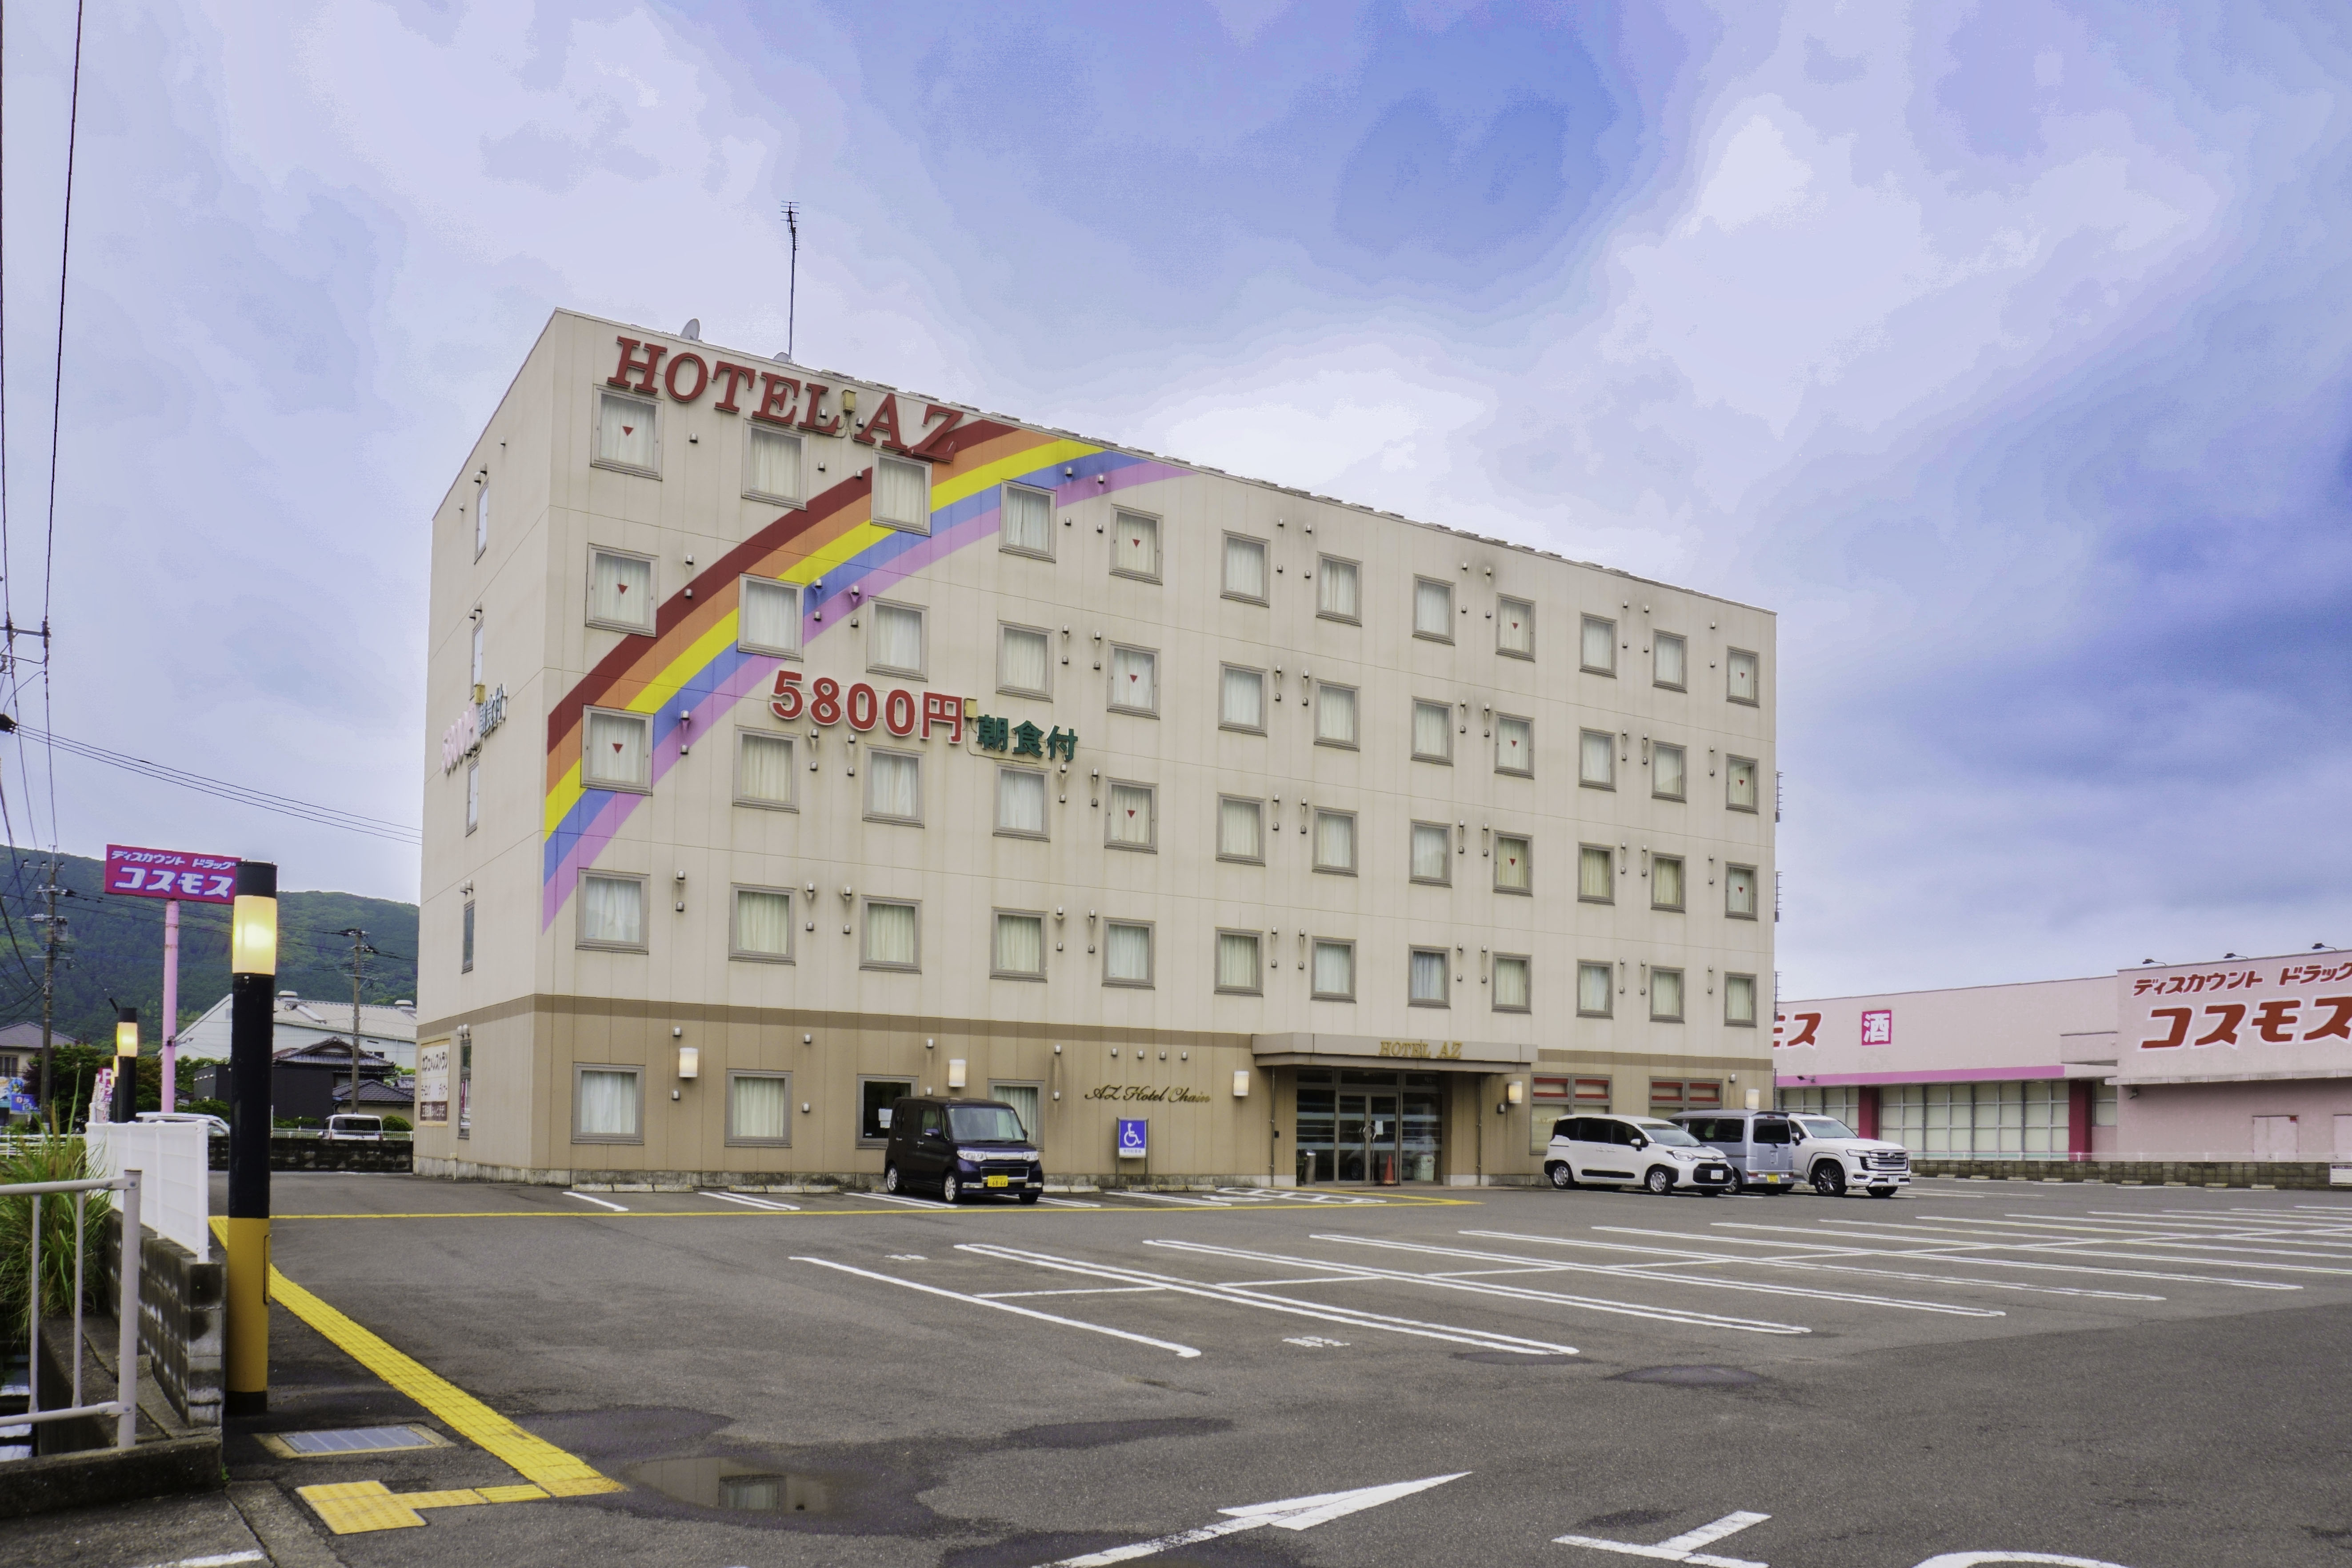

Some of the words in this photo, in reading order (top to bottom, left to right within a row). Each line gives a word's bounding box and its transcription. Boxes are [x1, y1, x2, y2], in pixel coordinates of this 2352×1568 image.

[607, 336, 840, 435] HOTEL
[854, 392, 964, 462] AZ
[770, 669, 964, 745] 5800円
[977, 714, 1079, 762] 朝食付
[111, 850, 185, 865] ディスカウント
[192, 858, 236, 870] ドラッグ
[114, 867, 233, 898] コスモス
[2133, 970, 2263, 996] ディスカウント
[1863, 1012, 1890, 1043] 酒
[2140, 996, 2352, 1048] コスモス
[1379, 1040, 1431, 1058] HOTEL
[1436, 1041, 1462, 1059] AZ
[1084, 1084, 1122, 1100] AZ
[1123, 1086, 1170, 1102] Hotel
[1168, 1086, 1211, 1103] Chain
